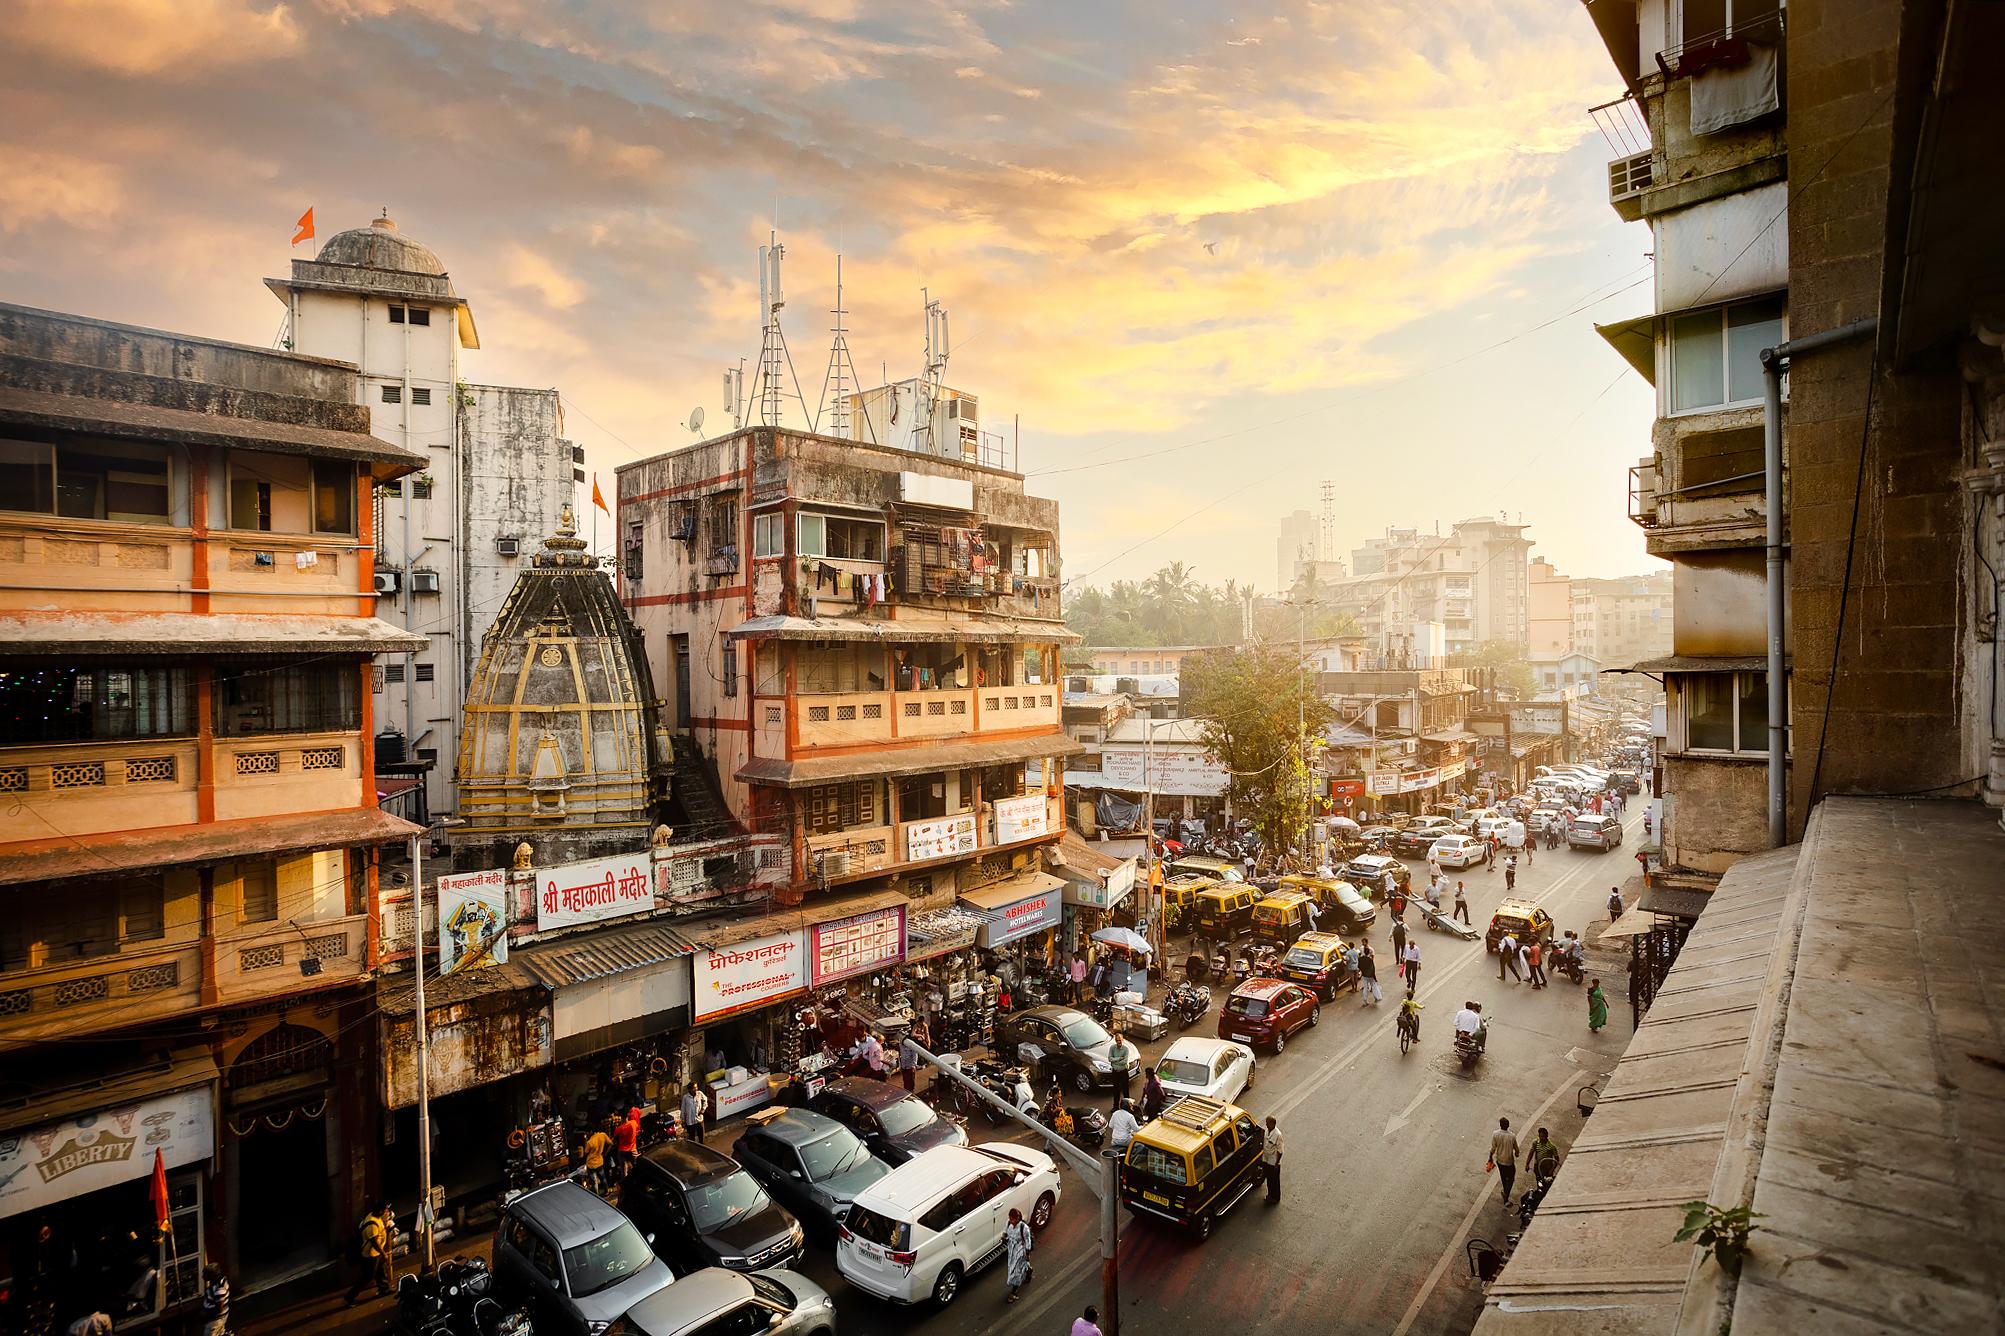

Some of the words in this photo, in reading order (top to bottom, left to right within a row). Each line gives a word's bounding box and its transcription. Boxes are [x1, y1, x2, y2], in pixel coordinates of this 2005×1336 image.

[543, 881, 558, 914] श्री
[561, 871, 615, 912] महाकाली
[618, 867, 648, 900] मंदीर
[1005, 898, 1047, 919] ABHISHEK
[708, 942, 792, 971] प्रोफेशनल
[720, 973, 791, 997] PROFESSIONAL
[760, 980, 790, 993] COURIERS
[39, 1142, 133, 1180] LIBERTY
